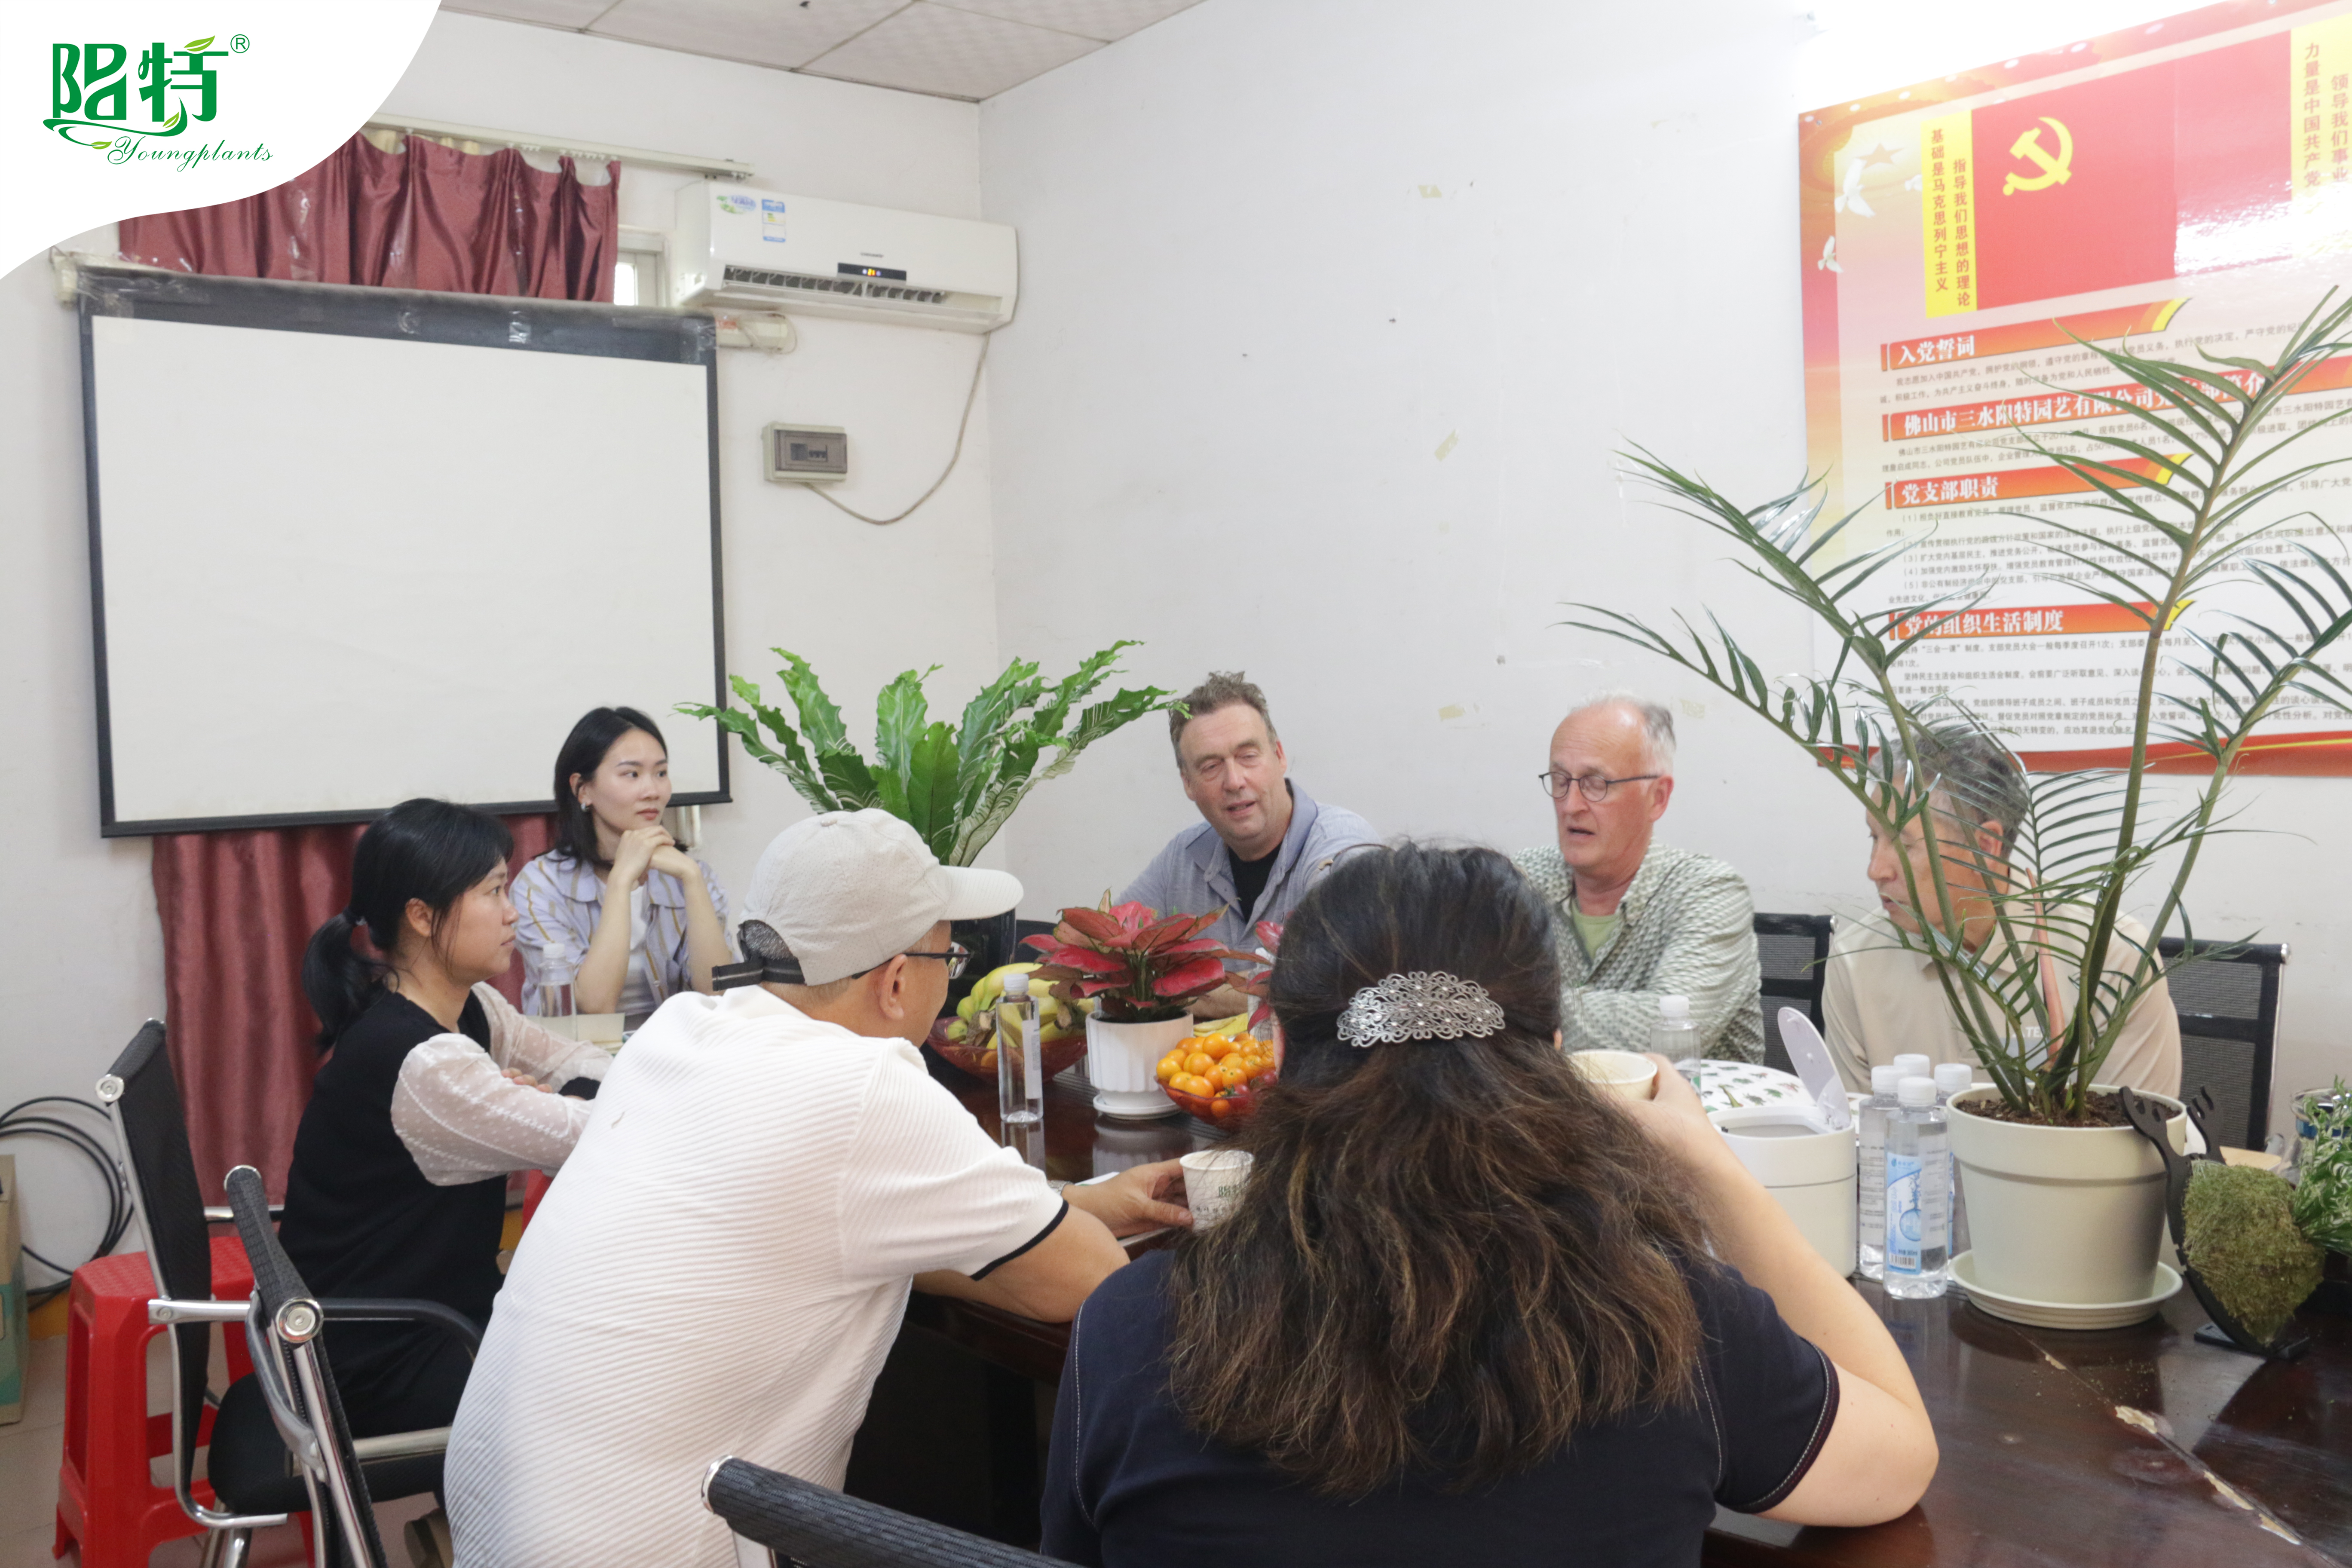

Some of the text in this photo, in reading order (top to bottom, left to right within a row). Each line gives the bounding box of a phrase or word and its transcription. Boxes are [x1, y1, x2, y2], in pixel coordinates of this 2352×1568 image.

[2303, 43, 2320, 188] 力量是中国共产党
[1931, 129, 1948, 292] 基础是马克思列宁主义
[1953, 159, 1970, 306] 指导我们思想的理论
[1898, 334, 1975, 365] 入党誓词
[1904, 371, 2266, 436] 佛山市三水阳特园艺有限公司党部简介
[1902, 477, 2000, 505] 党支部职责
[1904, 609, 2064, 637] 党的组织生活制度
